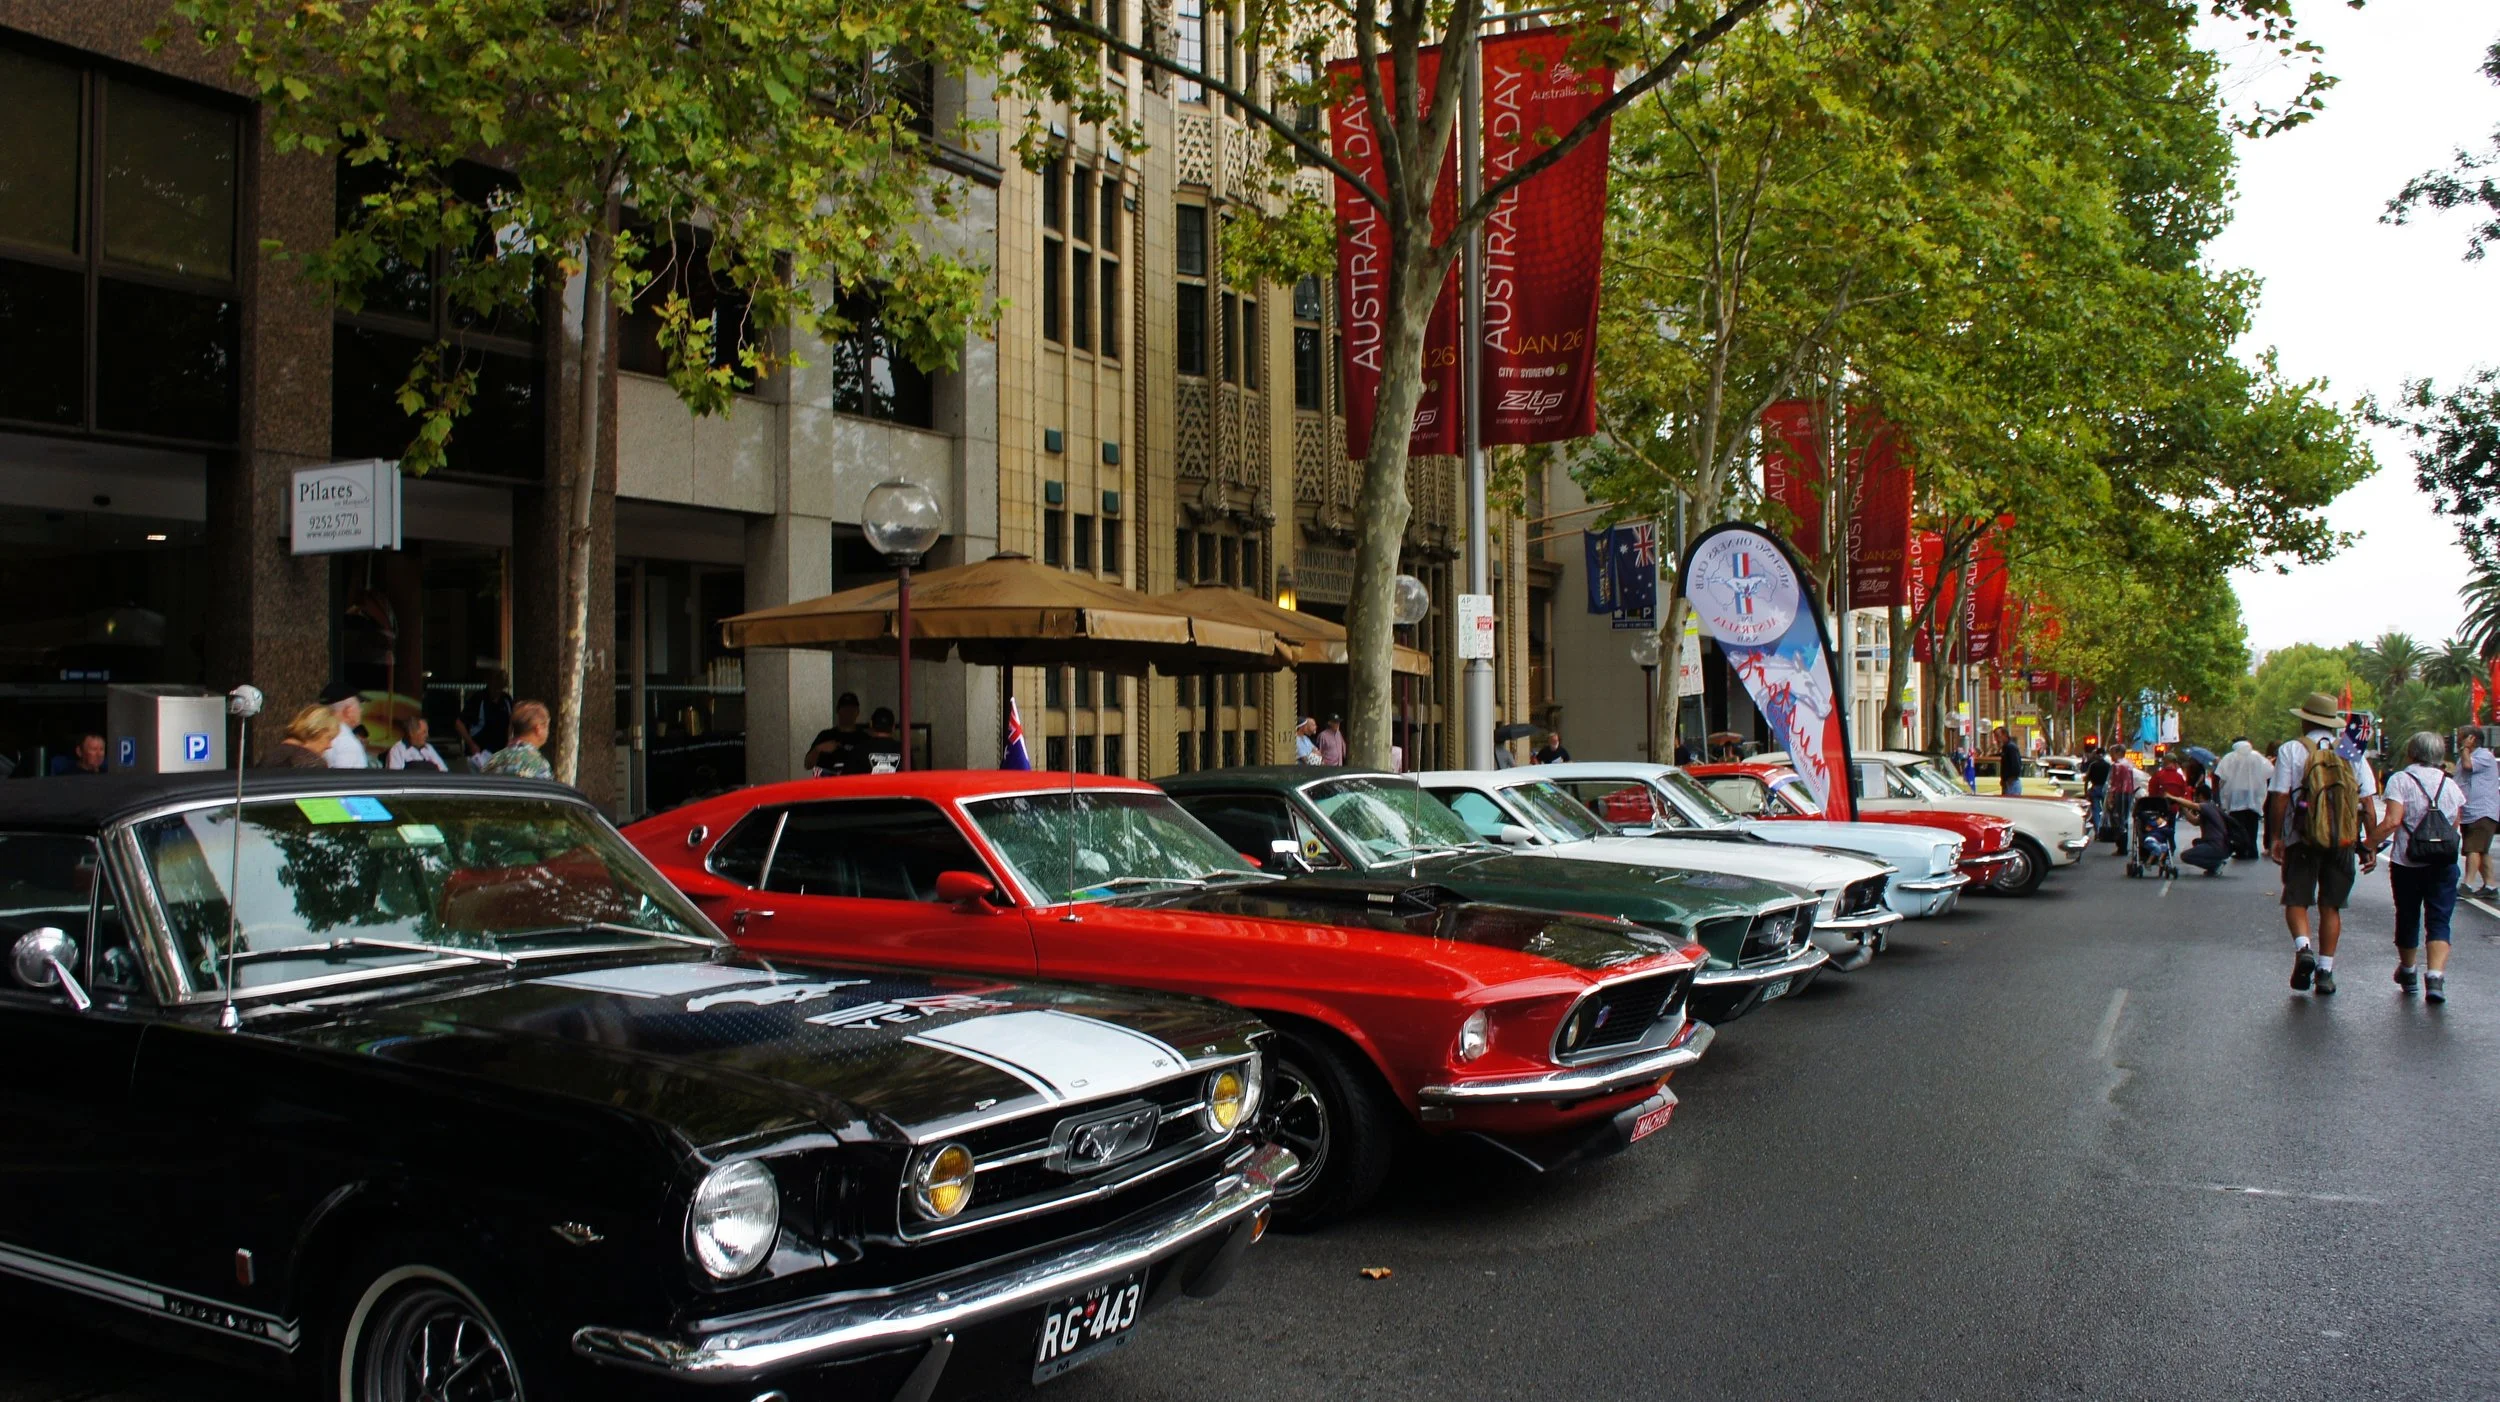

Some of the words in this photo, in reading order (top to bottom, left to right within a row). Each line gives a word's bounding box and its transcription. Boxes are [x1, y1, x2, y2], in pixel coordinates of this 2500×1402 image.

[1493, 65, 1521, 137] DAY
[1509, 334, 1559, 356] JAN
[1562, 328, 1584, 352] 26
[1432, 347, 1455, 368] 26
[300, 480, 353, 502] Pilates
[309, 515, 332, 530] 9252
[335, 512, 358, 528] 5770
[189, 736, 206, 760] P
[1086, 1284, 1109, 1301] NSW
